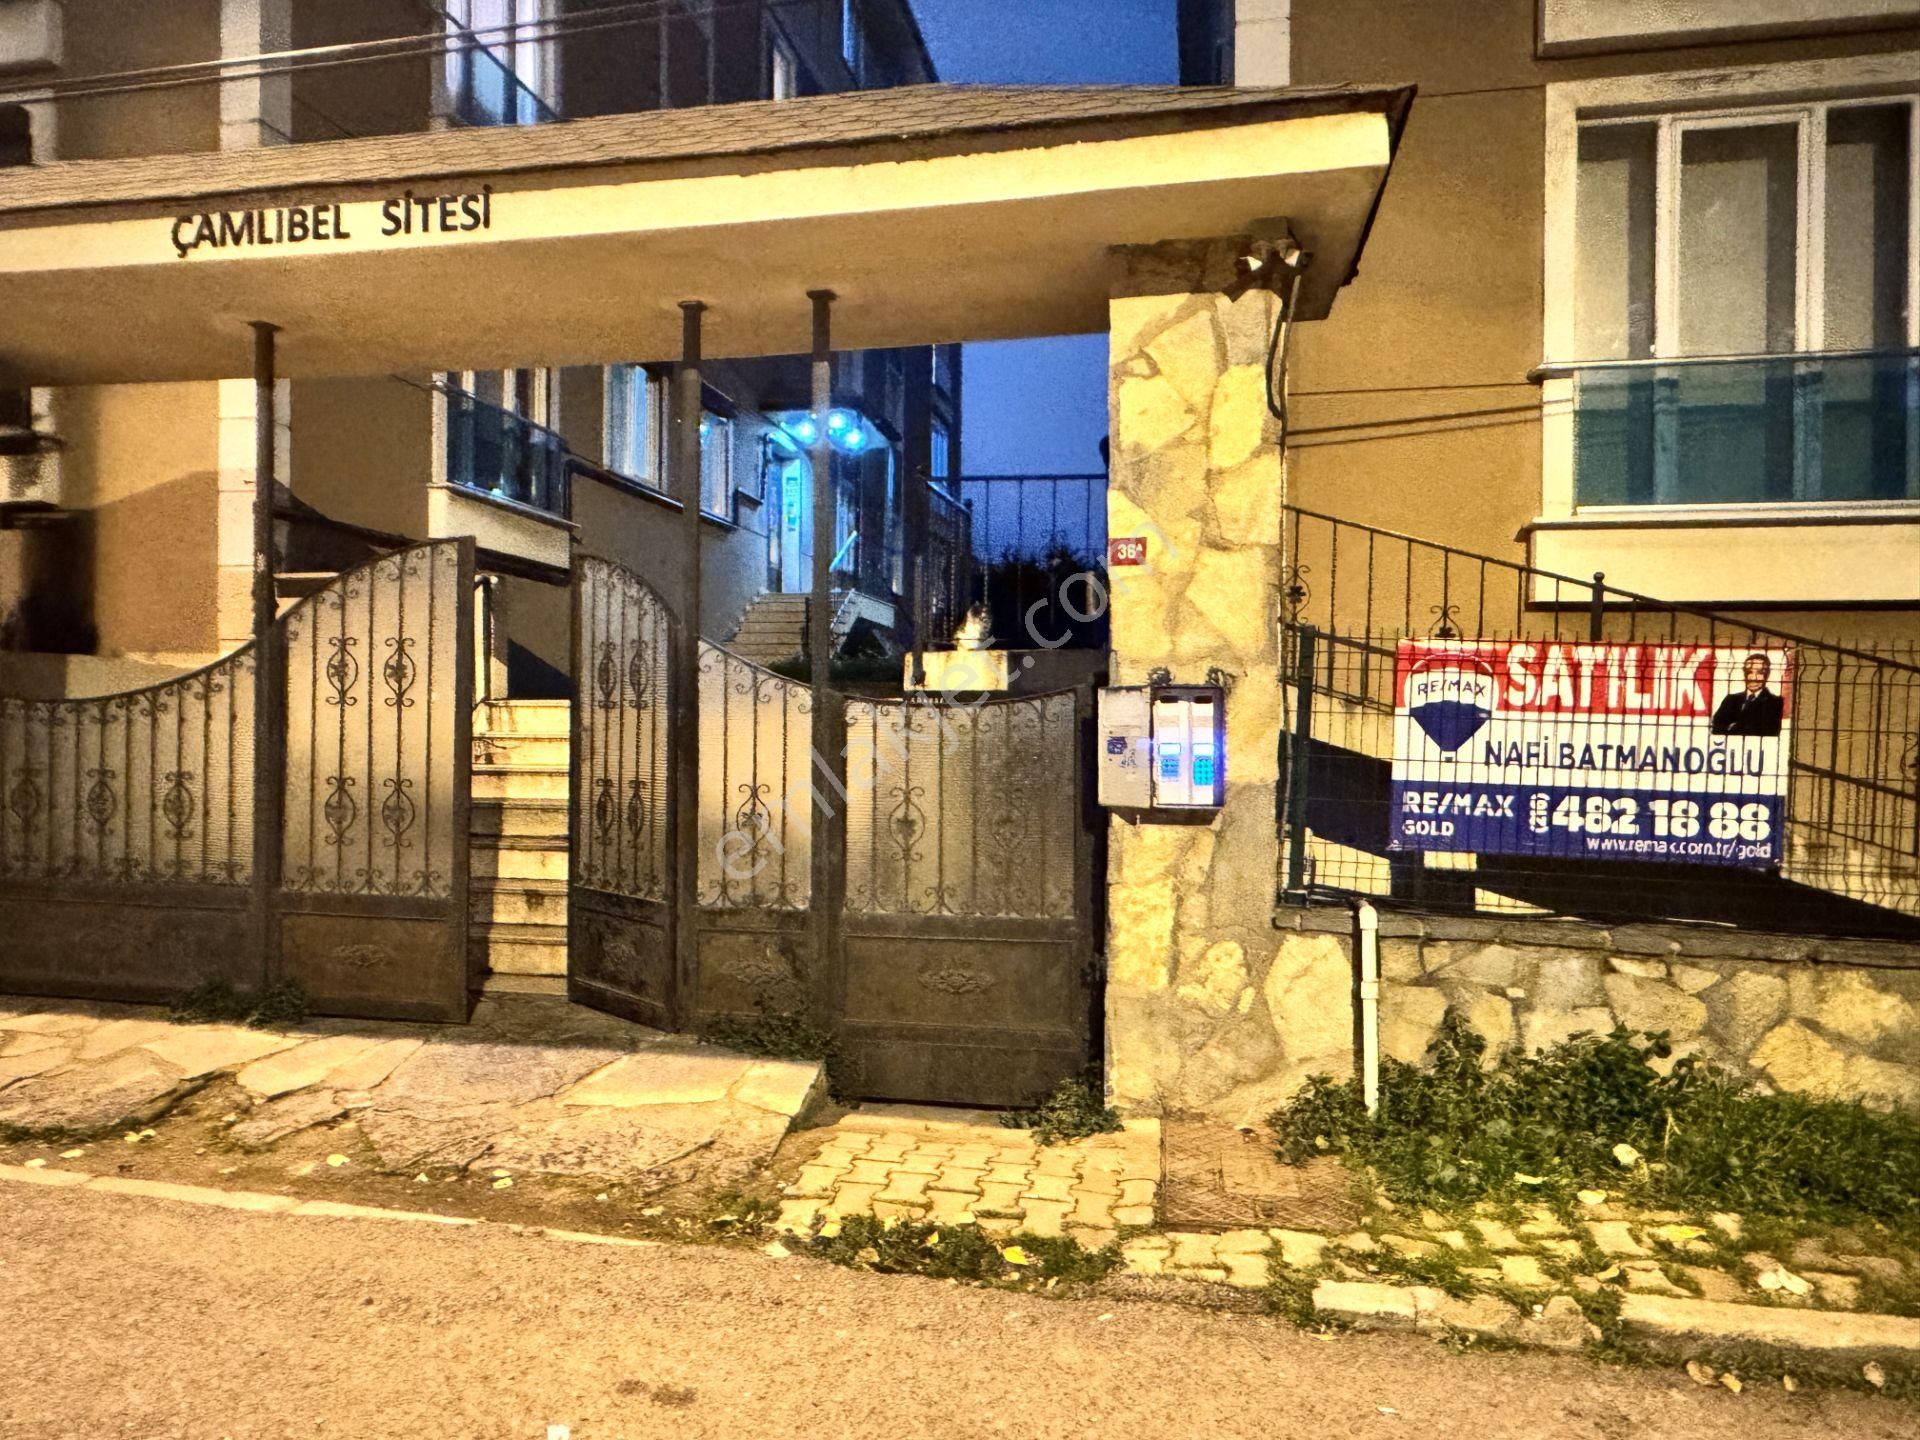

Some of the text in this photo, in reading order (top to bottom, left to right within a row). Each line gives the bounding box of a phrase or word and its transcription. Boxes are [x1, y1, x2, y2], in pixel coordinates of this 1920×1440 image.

[171, 183, 492, 258] ÇAMLIBEL SİTESİ
[1417, 679, 1487, 697] RE/MAX
[1504, 644, 1707, 711] SATILIK
[1485, 736, 1765, 777] NAFİ BATMANOĞLU
[1402, 790, 1516, 818] RE/MAX
[1551, 795, 1641, 835] 482
[1648, 799, 1700, 838] 18
[1708, 802, 1771, 841] 88
[1402, 819, 1455, 837] GOLD
